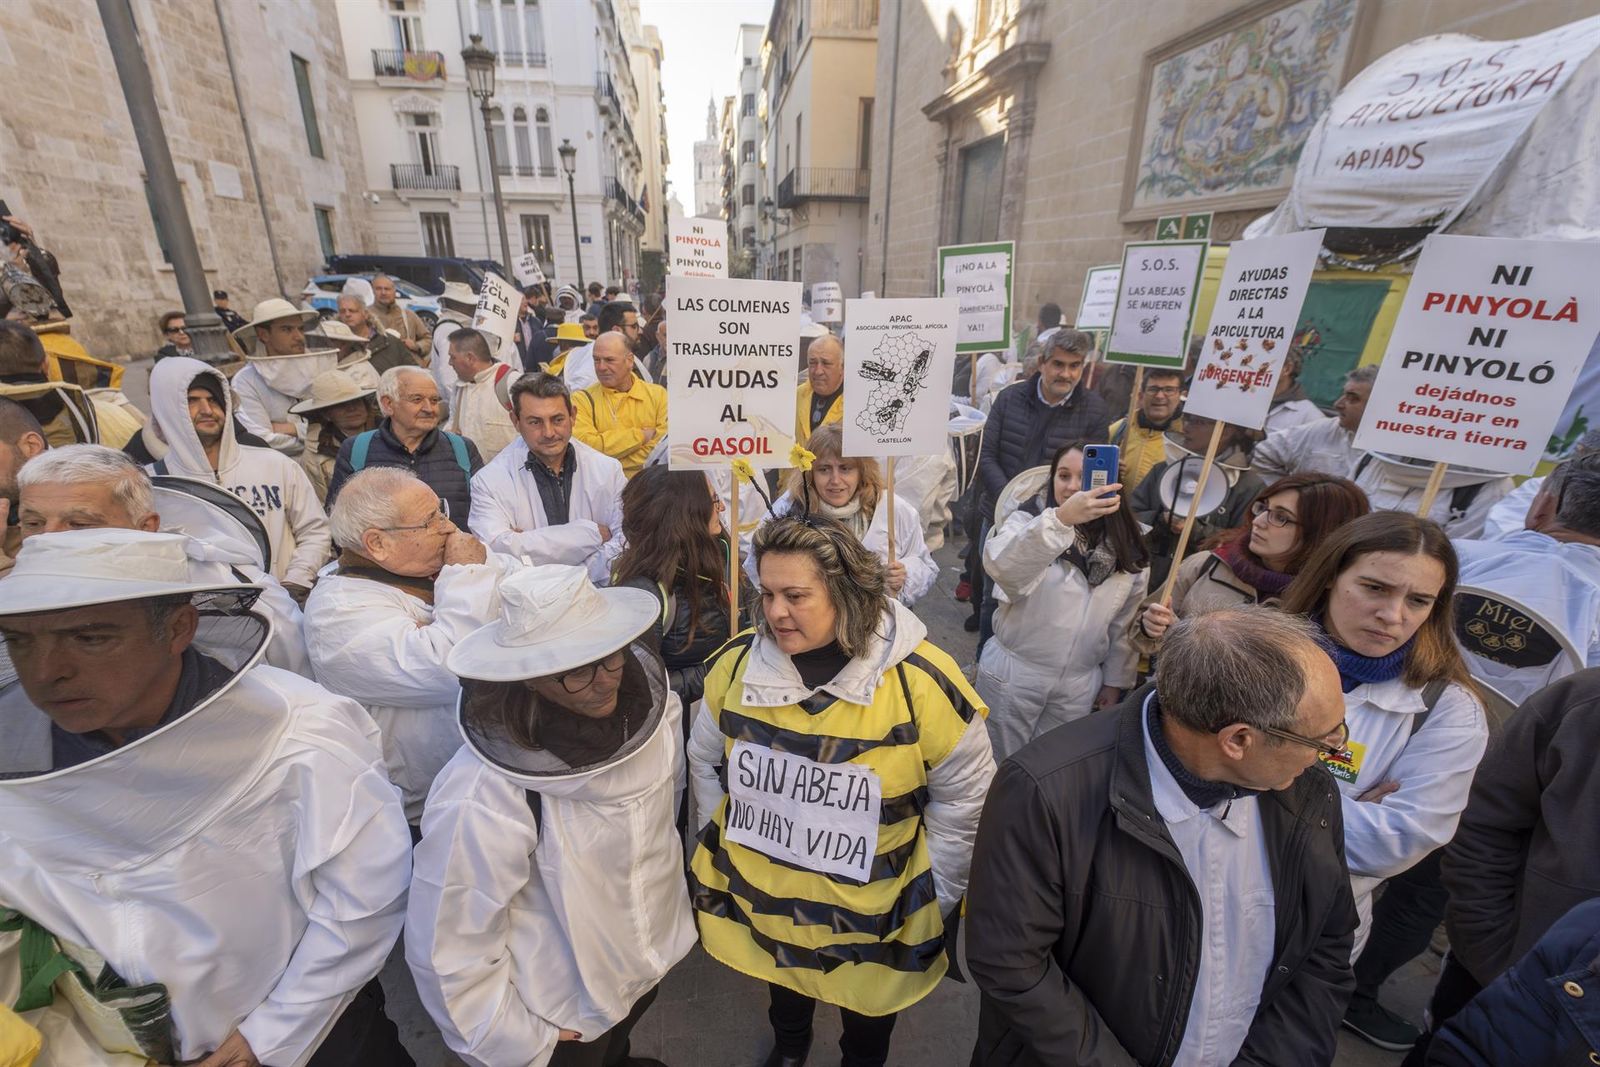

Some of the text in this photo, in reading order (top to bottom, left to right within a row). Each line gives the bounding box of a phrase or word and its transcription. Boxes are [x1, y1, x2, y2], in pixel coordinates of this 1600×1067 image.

[1339, 60, 1567, 128] APICULTURA
[692, 226, 704, 234] NI
[693, 249, 704, 257] NI
[977, 262, 984, 270] A
[985, 261, 997, 270] LA
[1140, 258, 1180, 271] S.O.S.
[1238, 266, 1288, 283] AYUDAS
[1491, 265, 1533, 286] NI
[481, 285, 510, 307] ZCLA
[1128, 286, 1145, 296] LAS
[1147, 286, 1186, 297] ABEJAS
[1229, 286, 1288, 301] DIRECTAS
[477, 301, 507, 319] ELES
[677, 298, 790, 314] LAS COLMENAS
[959, 304, 1003, 314] OAMBIENTALES
[1127, 300, 1182, 310] SE MUEREN
[1237, 307, 1264, 319] A LA
[1422, 292, 1579, 323] PINYOLÀ
[718, 321, 750, 335] SON
[967, 323, 985, 332] YA!!
[1211, 325, 1285, 339] APICULTURA
[1468, 327, 1508, 348] NI
[672, 342, 793, 357] TRASHUMANTES
[1401, 351, 1555, 384] PINYOLÓ
[687, 369, 779, 389] AYUDAS
[1415, 384, 1517, 407] dejádnos
[720, 404, 748, 423] AL
[1398, 401, 1519, 428] trabajar en
[1376, 419, 1528, 450] nuestra tierra
[692, 437, 773, 457] GASOIL
[1475, 600, 1537, 633] Miel
[738, 749, 870, 812] SIN ABEJA
[731, 799, 868, 869] NO HAY VIDA
